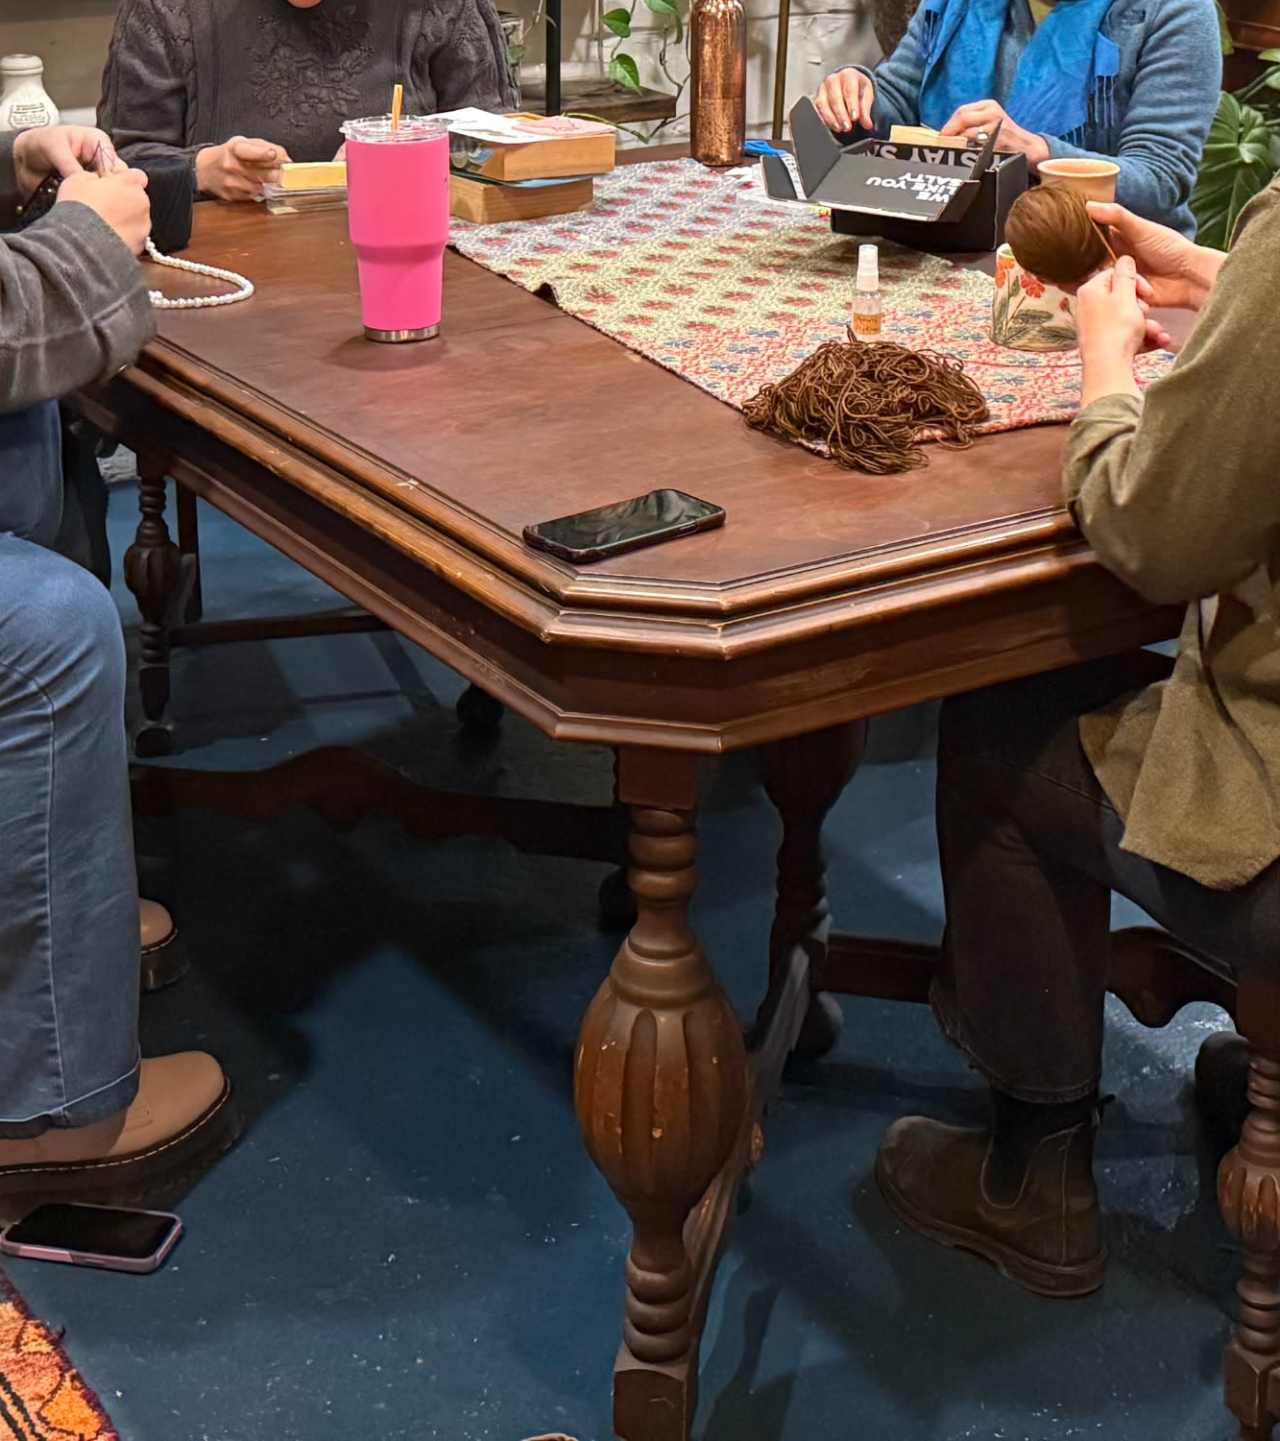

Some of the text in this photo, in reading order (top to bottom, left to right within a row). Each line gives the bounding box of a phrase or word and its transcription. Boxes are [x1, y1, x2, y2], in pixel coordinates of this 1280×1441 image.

[909, 147, 978, 169] STAY
[865, 176, 958, 196] LIKE YOU
[899, 172, 965, 187] SALTY
[915, 191, 950, 203] WE
